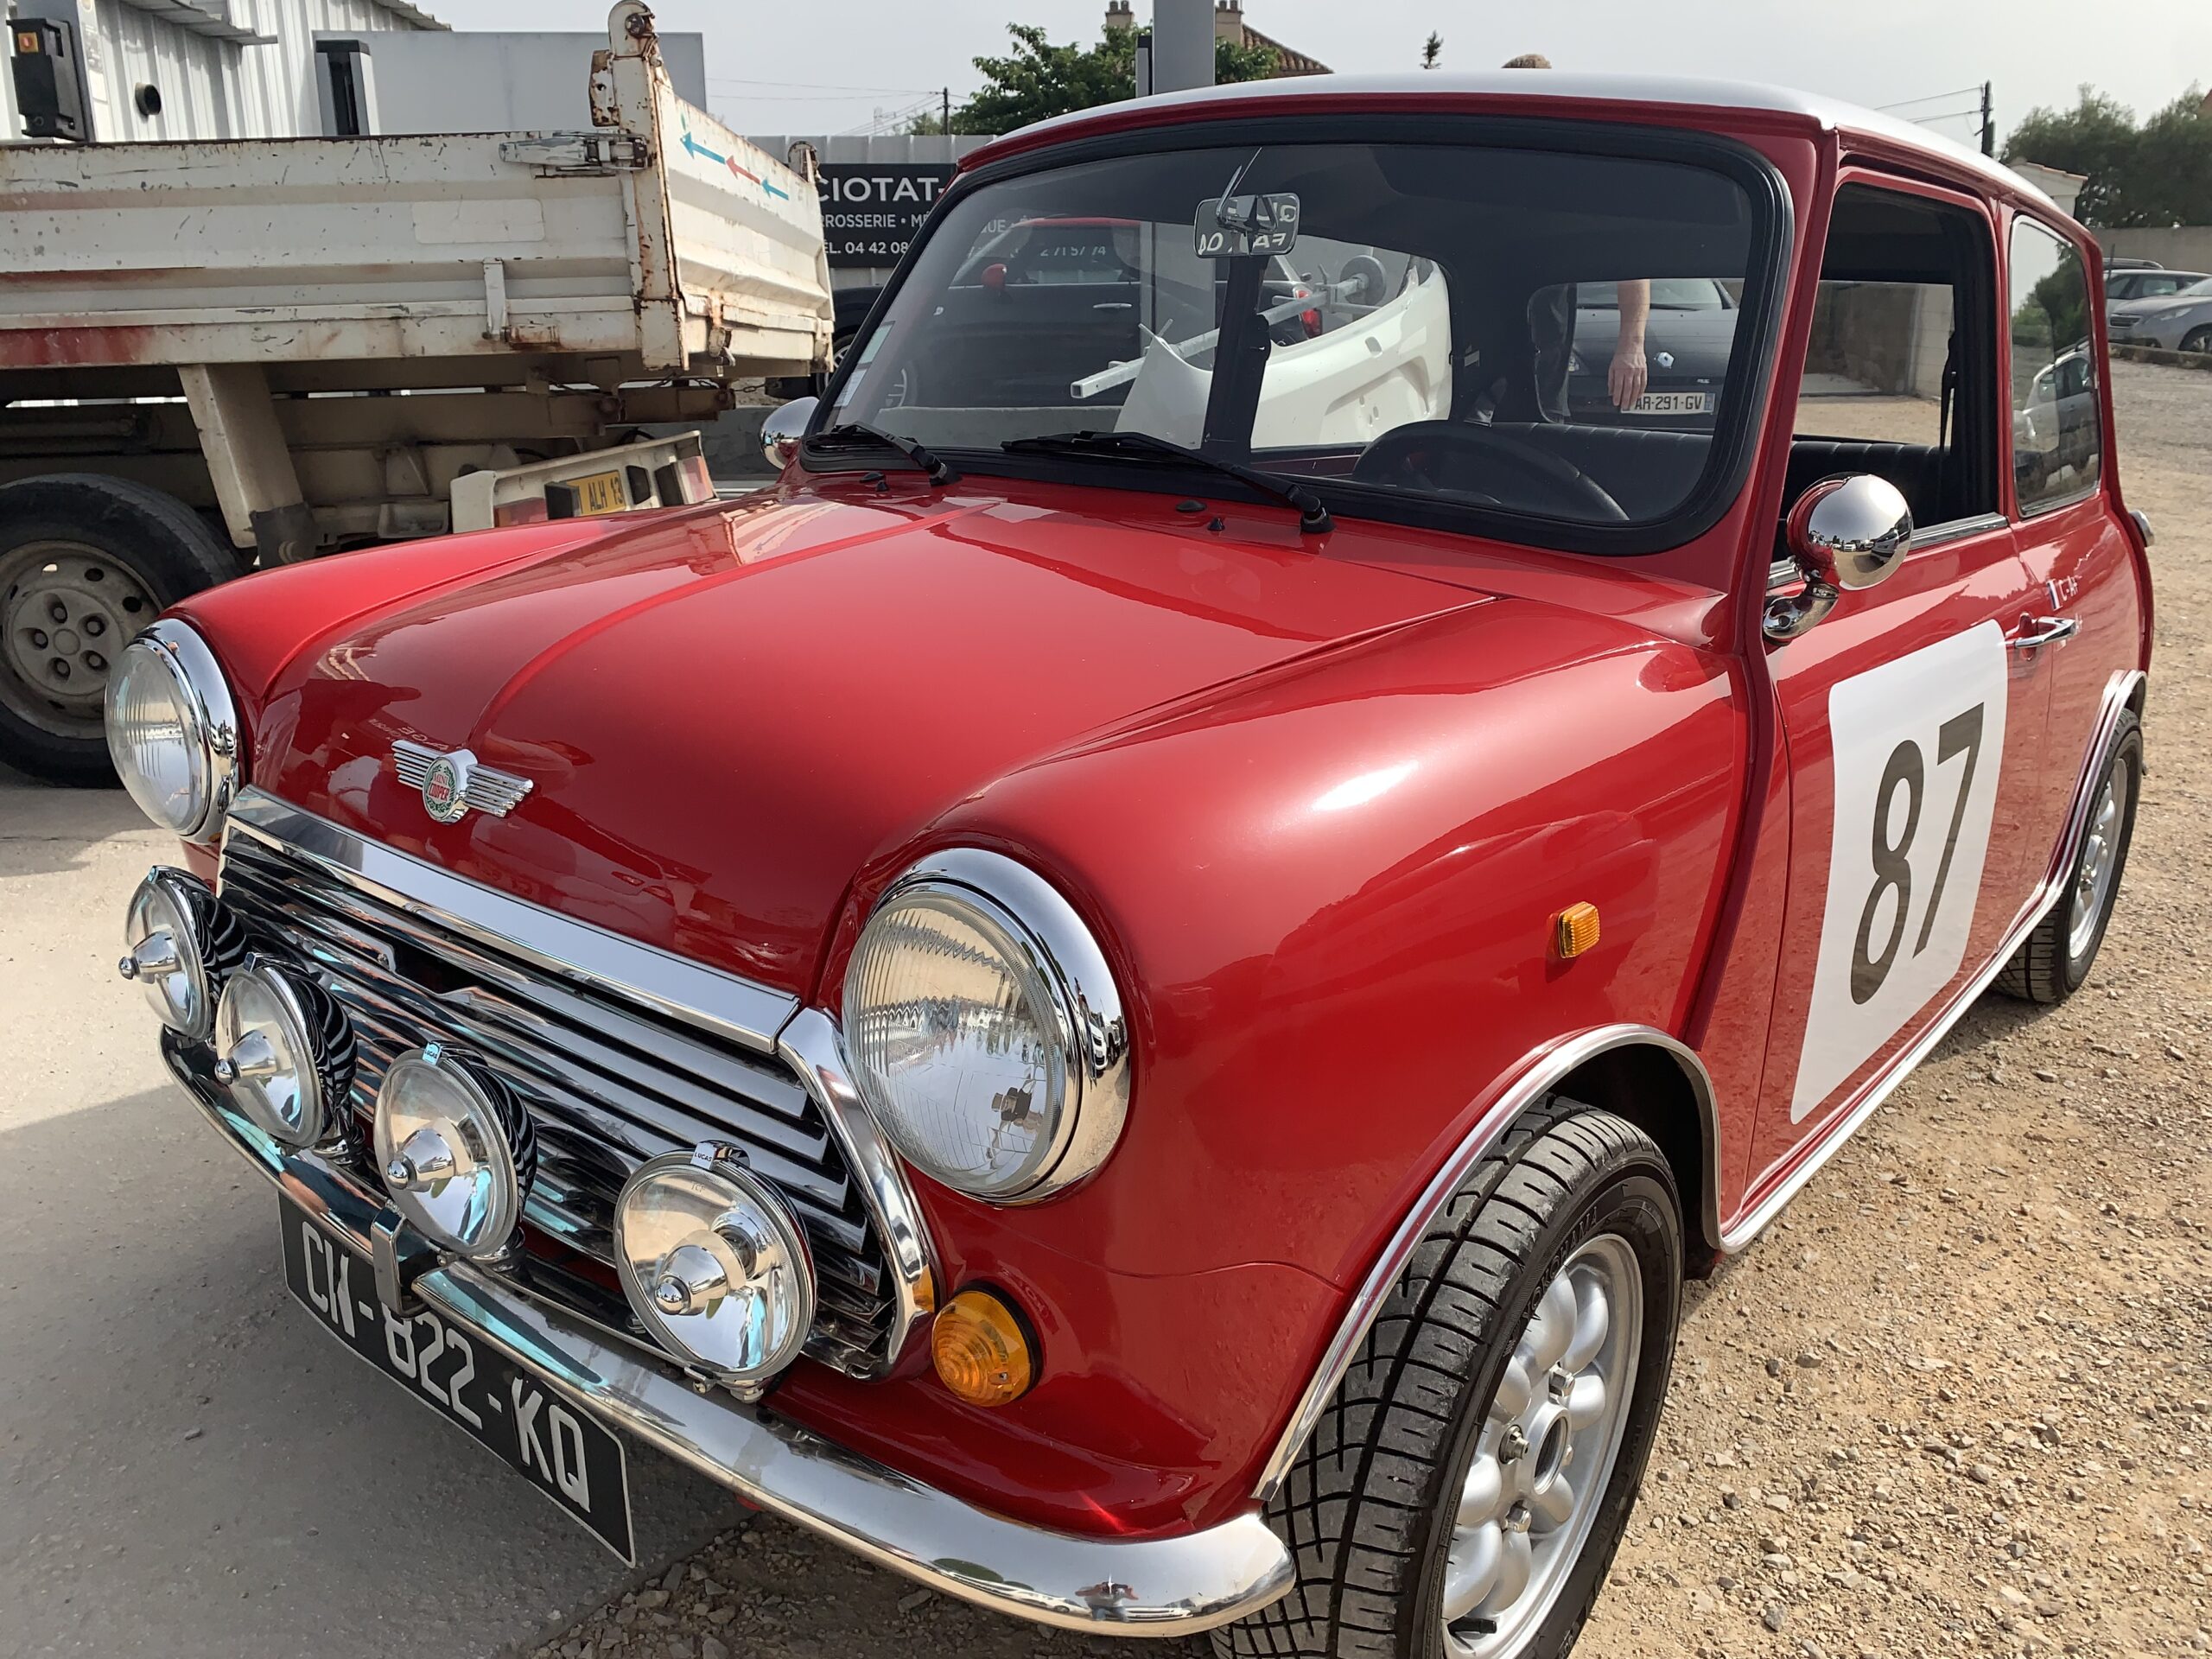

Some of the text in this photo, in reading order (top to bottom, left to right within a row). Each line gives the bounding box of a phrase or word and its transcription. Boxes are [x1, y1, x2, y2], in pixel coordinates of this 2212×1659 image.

[845, 242, 864, 254] 04
[868, 242, 887, 254] 42
[1634, 396, 1702, 410] AR-291-GV
[1851, 702, 1984, 1005] 87
[695, 1152, 712, 1162] LUCAS
